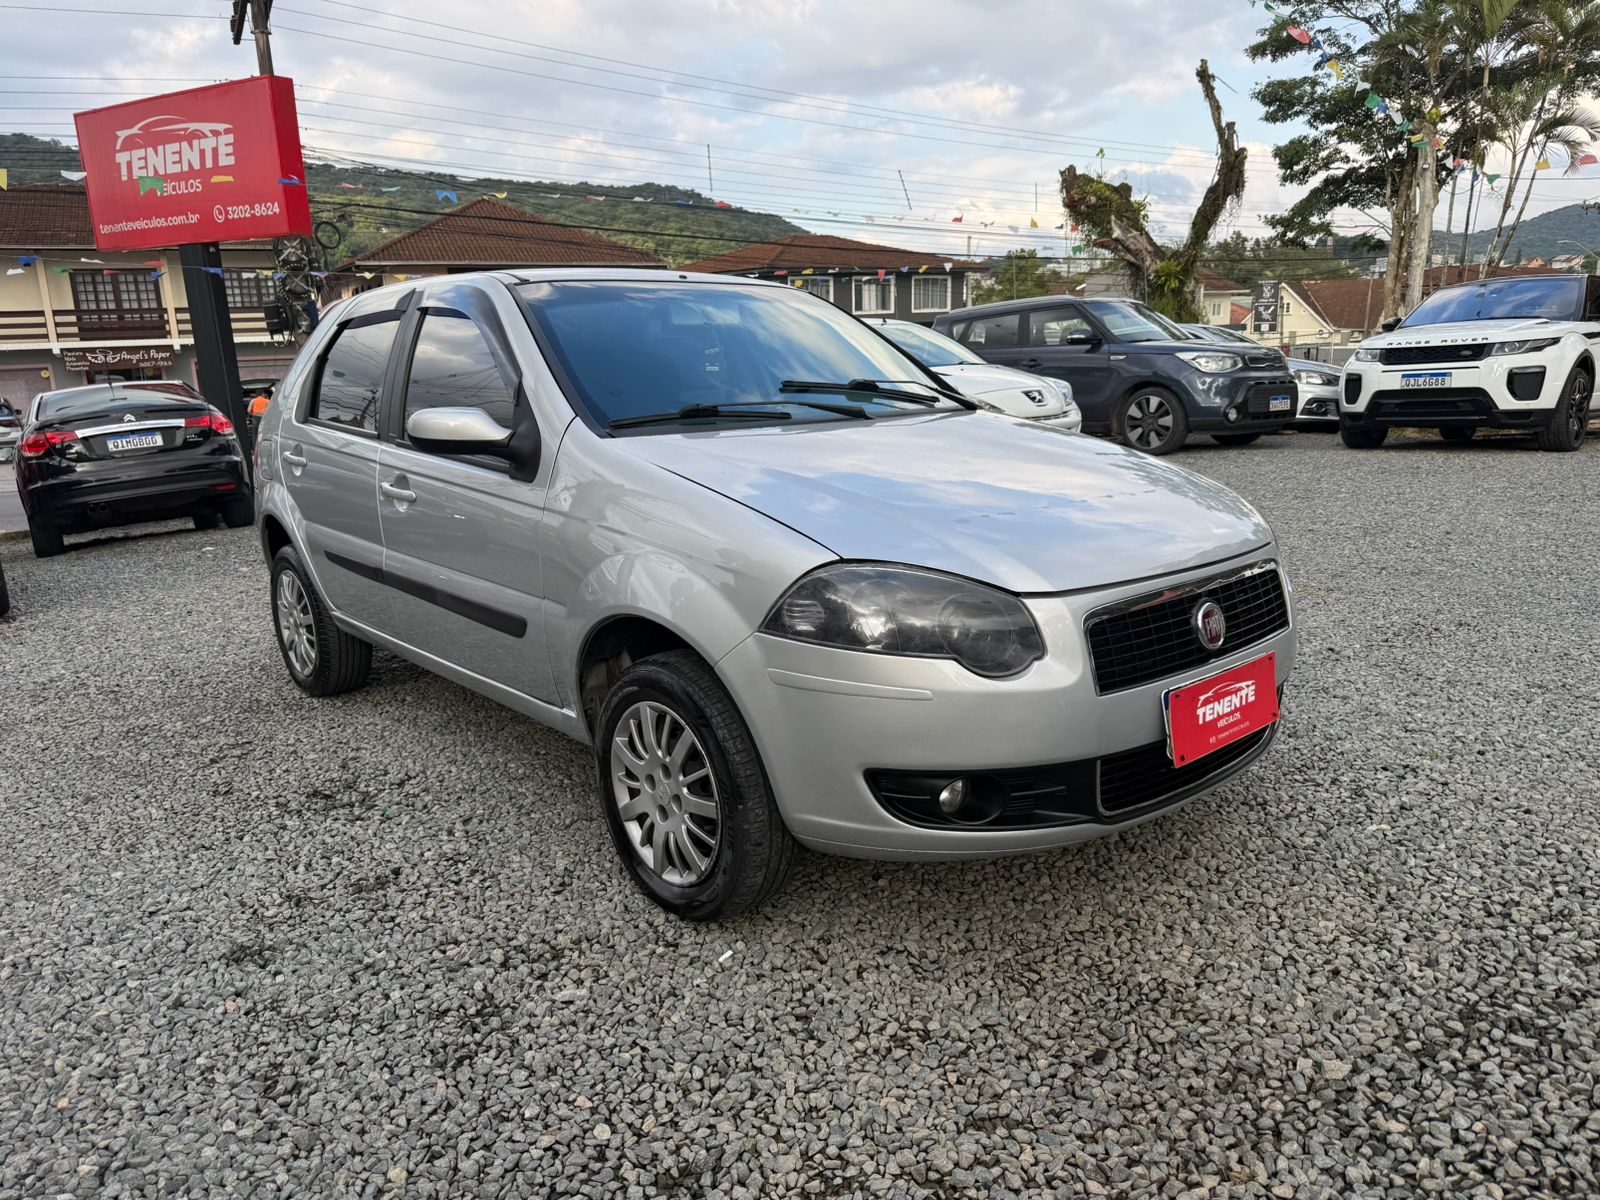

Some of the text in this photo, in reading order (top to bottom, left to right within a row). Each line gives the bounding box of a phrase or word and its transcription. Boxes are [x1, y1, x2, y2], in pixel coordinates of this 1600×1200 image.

[115, 133, 235, 181] TENENTE
[227, 201, 280, 219] 3202-8624
[121, 349, 171, 364] Angel's Paper
[1404, 377, 1446, 387] QJL6G88
[1196, 685, 1256, 725] TENENTE
